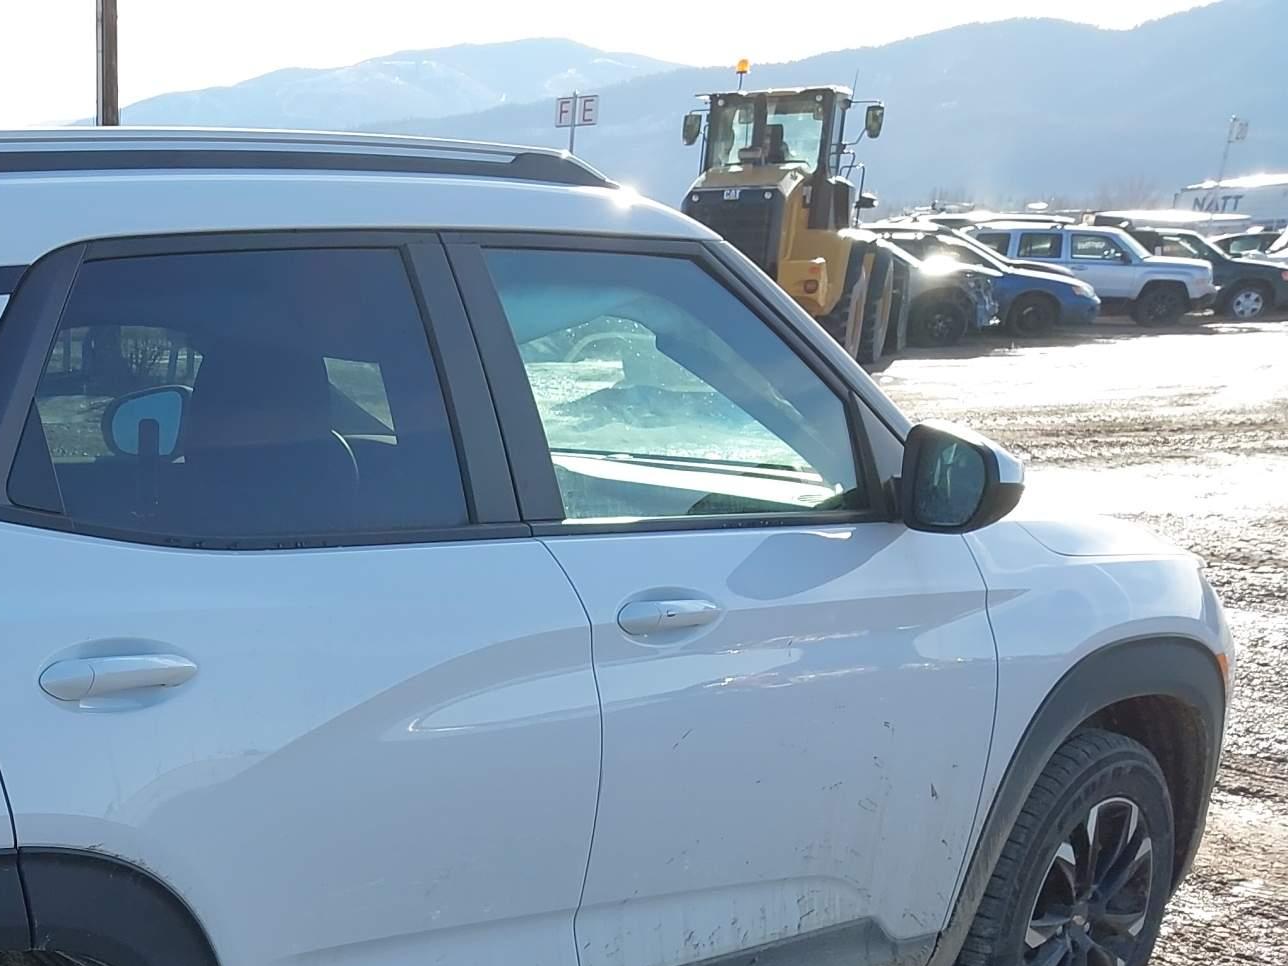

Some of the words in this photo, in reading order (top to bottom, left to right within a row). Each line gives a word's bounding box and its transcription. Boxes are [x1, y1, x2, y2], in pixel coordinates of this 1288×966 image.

[559, 101, 571, 124] F
[582, 99, 595, 122] E
[723, 189, 741, 201] CAT
